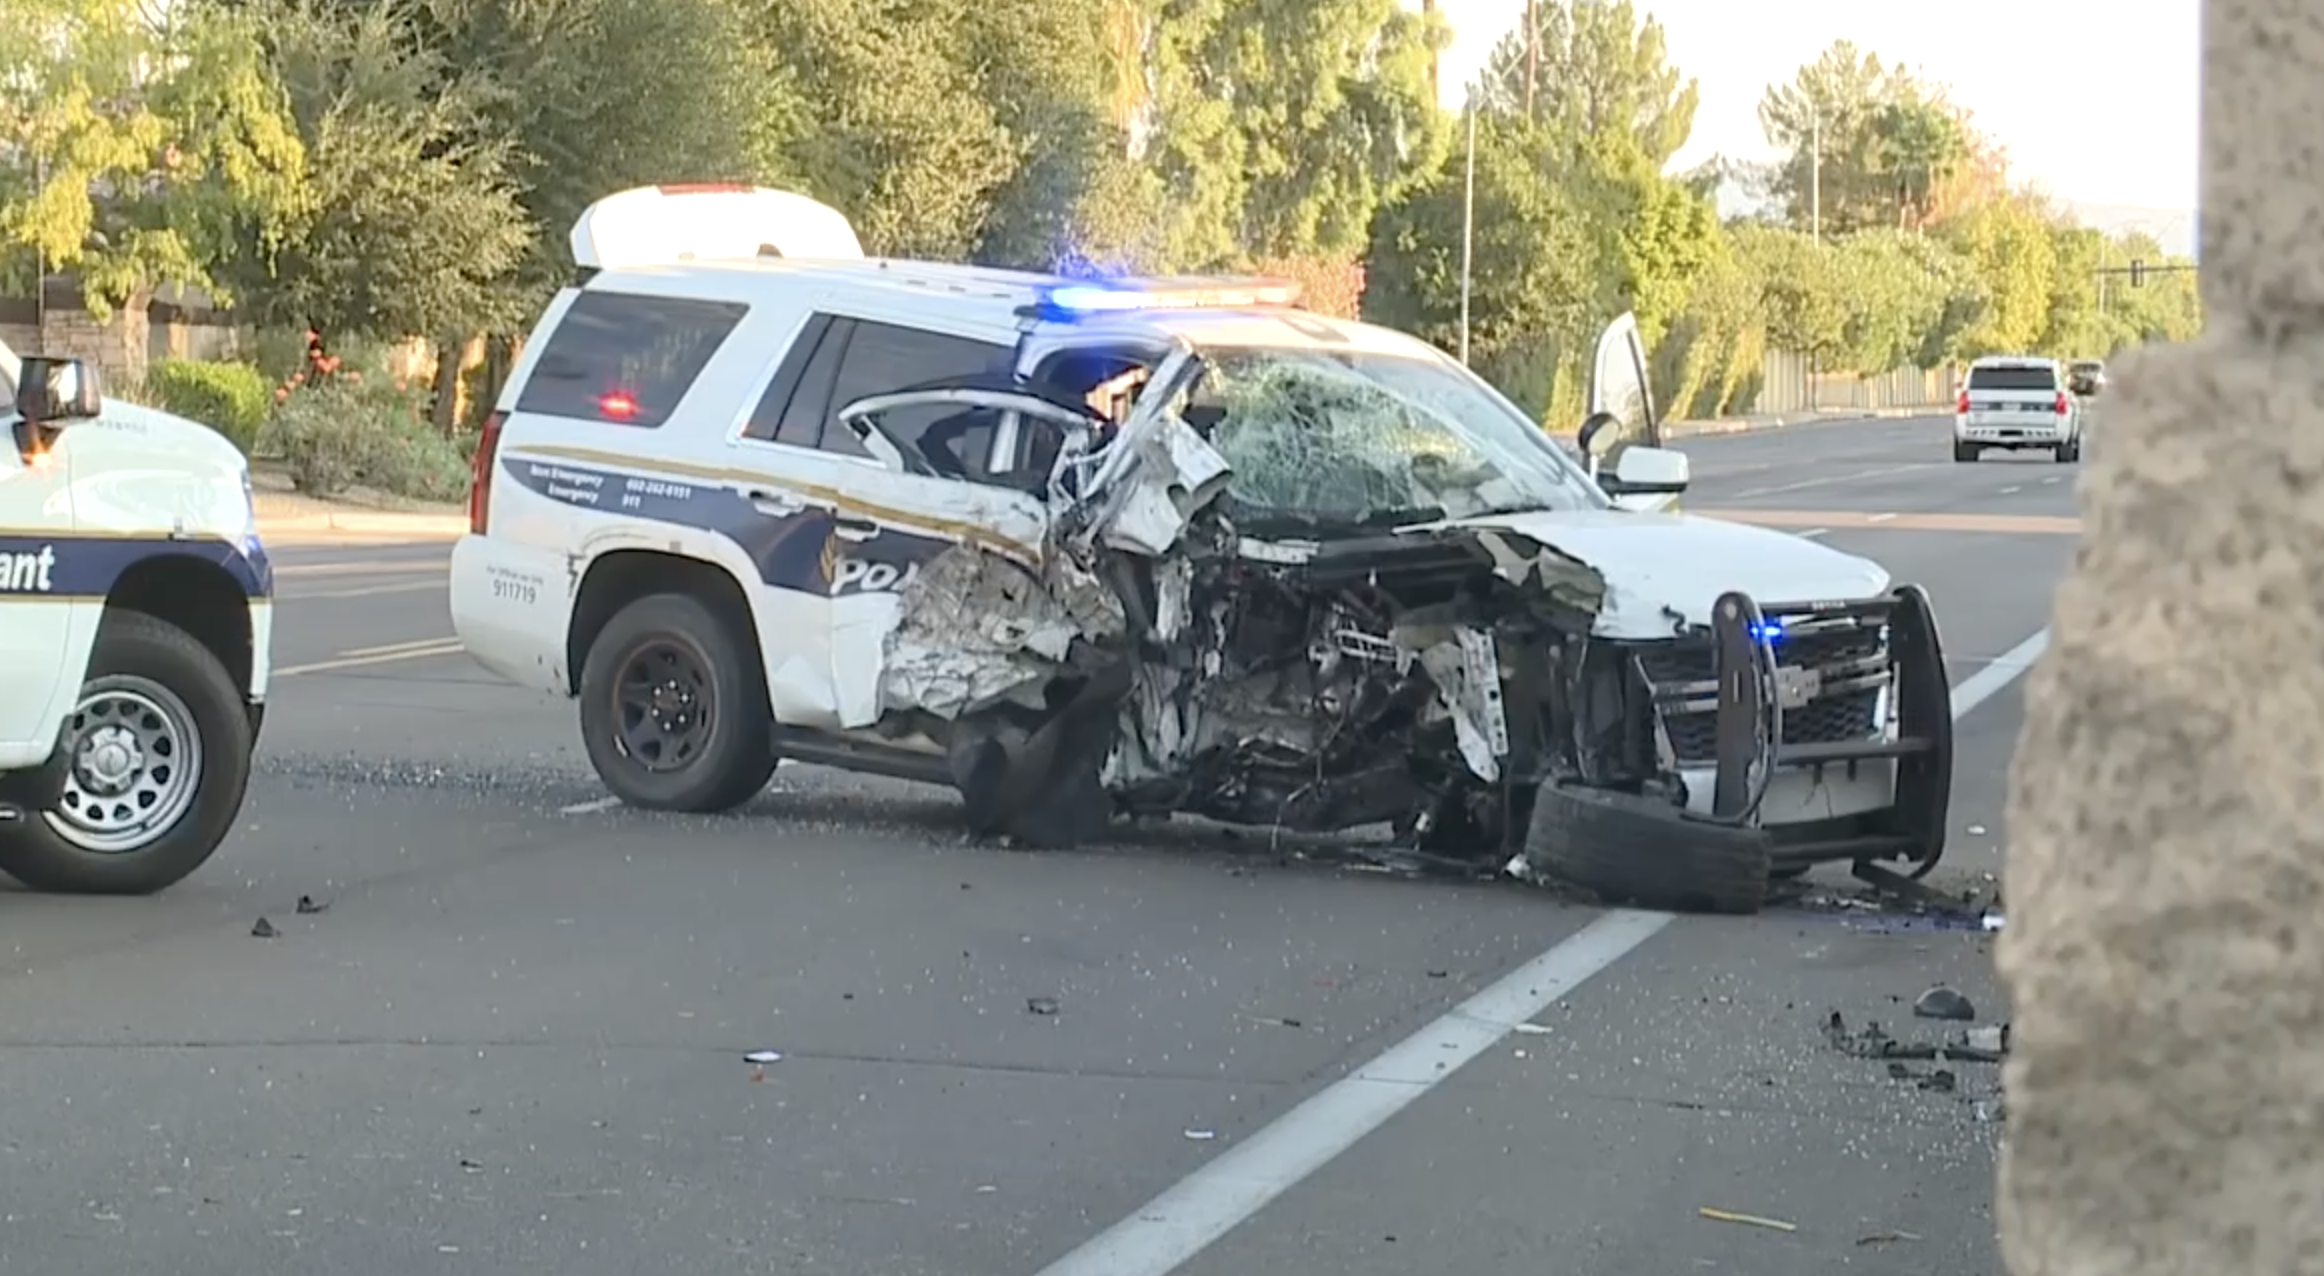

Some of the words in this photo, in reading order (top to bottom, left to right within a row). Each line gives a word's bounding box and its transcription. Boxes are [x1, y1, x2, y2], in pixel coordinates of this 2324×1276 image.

[551, 467, 603, 488] Emergency
[548, 483, 598, 503] Emergency
[493, 579, 537, 605] 911719
